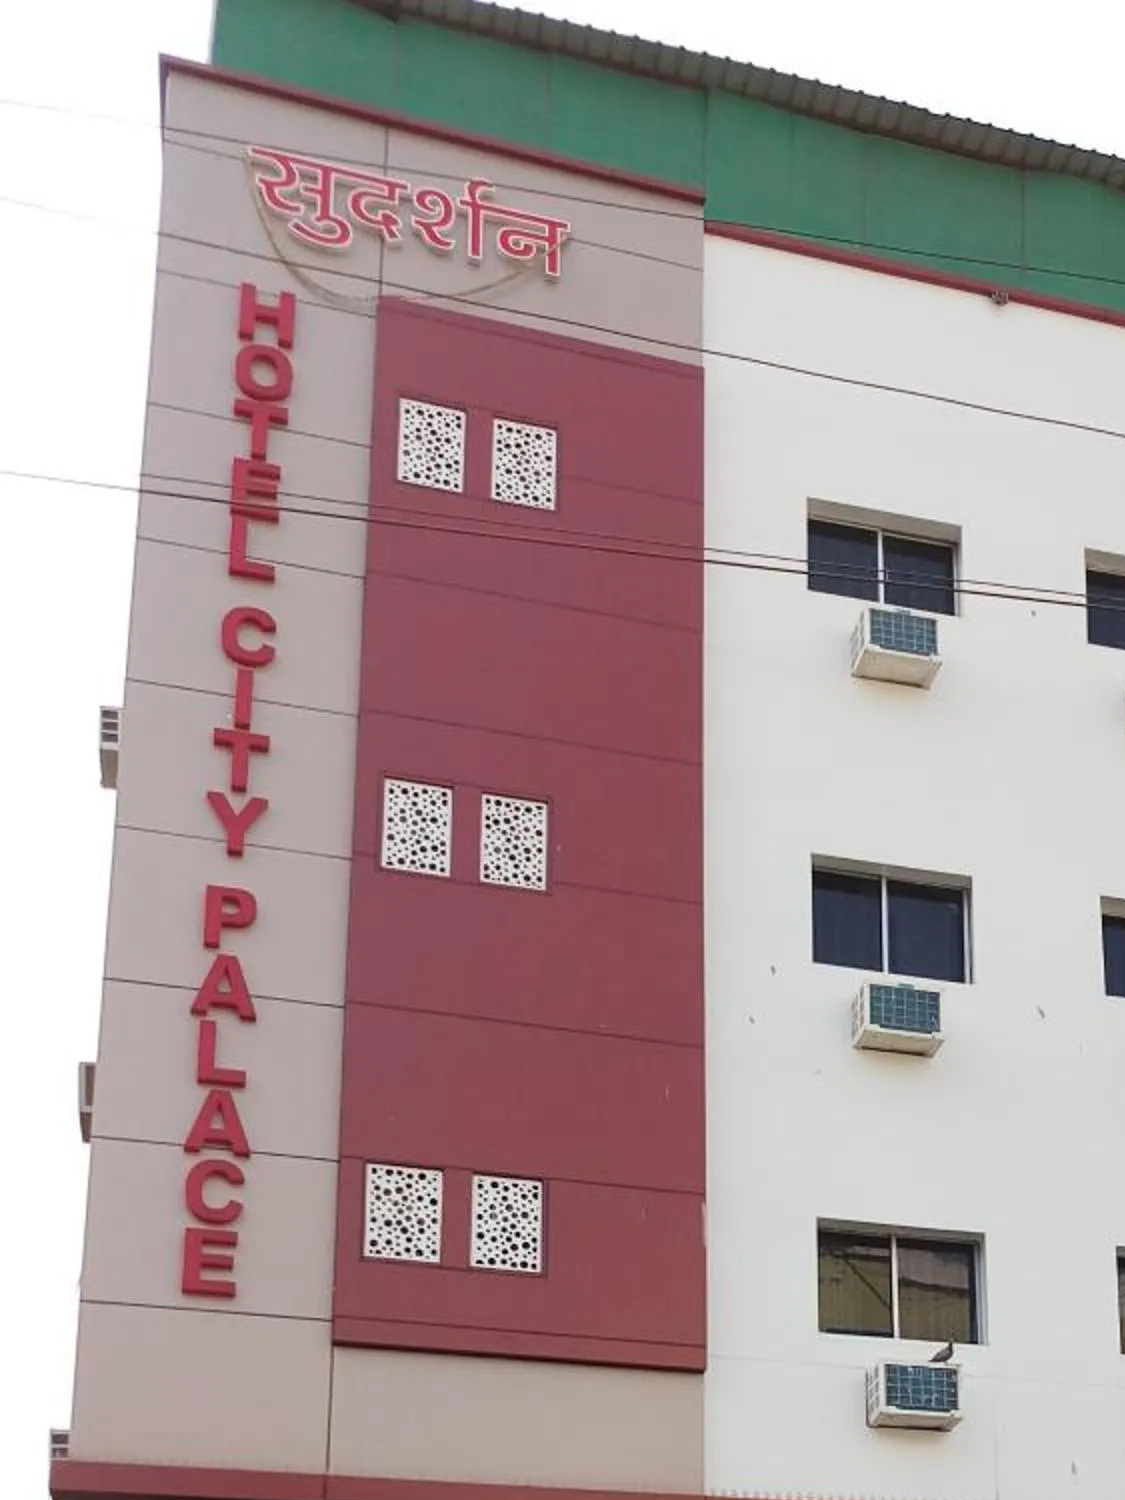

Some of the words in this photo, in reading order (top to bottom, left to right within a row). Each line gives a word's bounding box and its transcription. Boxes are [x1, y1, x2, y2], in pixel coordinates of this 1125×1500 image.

[246, 146, 571, 280] सुदर्शन
[227, 282, 295, 583] HOTEL
[206, 607, 276, 857] CITY
[181, 884, 257, 1299] PALACE
